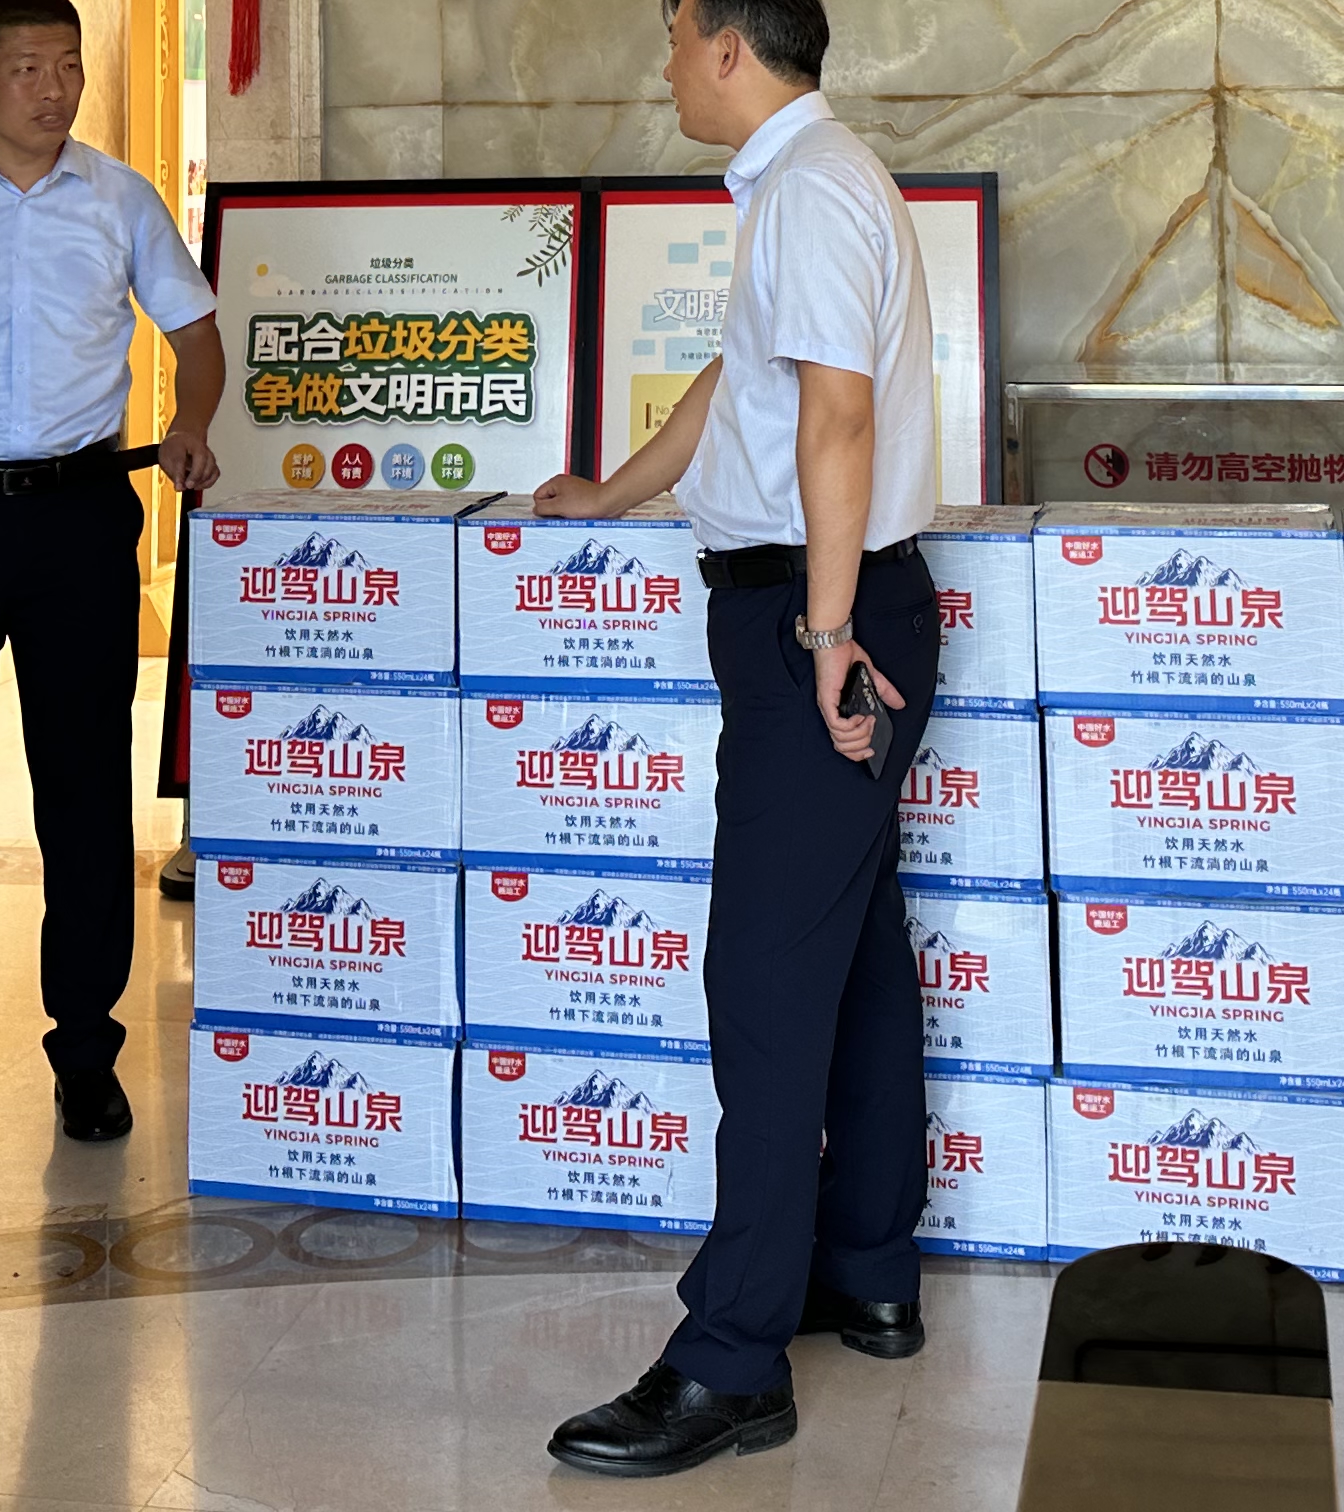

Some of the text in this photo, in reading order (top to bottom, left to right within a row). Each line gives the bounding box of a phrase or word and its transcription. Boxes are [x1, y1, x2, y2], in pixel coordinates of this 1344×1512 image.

[370, 257, 414, 270] 垃圾分类
[325, 273, 458, 284] GARBAGE CLASSIFICATION
[253, 318, 529, 363] 配合垃圾分类
[251, 372, 527, 417] 争做文明市民
[341, 454, 363, 465] 人人
[442, 454, 464, 465] 绿色
[341, 467, 362, 479] 有责
[441, 467, 463, 479] 环保
[239, 566, 401, 606] 迎驾山泉
[514, 574, 681, 613] 迎驾山泉
[261, 609, 377, 622] YINGJIA SPRING
[1098, 586, 1283, 628] 迎驾山泉
[538, 618, 658, 630] YINGJIA SPRING
[285, 628, 353, 642] 饮用天然水
[563, 637, 634, 651] 饮用天然水
[1125, 632, 1257, 646] YINGJIA SPRING
[264, 645, 374, 660] 竹根下流淌的山泉
[1153, 652, 1231, 667] 饮用天然水
[543, 655, 656, 669] 竹根下流淌的山泉
[1130, 671, 1256, 687] 竹根下流淌的山泉
[244, 738, 407, 781] 迎驾山泉
[516, 750, 686, 792] 迎驾山泉
[267, 782, 382, 798] YINGJIA SPRING
[899, 767, 980, 808] 山泉
[1110, 769, 1296, 814] 迎驾山泉
[290, 802, 359, 817] 饮用天然水
[540, 795, 661, 809] YINGJIA SPRING
[270, 819, 379, 836] 竹根下流淌的山泉
[565, 814, 636, 829] 饮用天然水
[898, 812, 955, 825] SPRING
[1137, 816, 1270, 832] YINGJIA SPRING
[544, 831, 658, 848] 竹根下流淌的山泉
[1165, 837, 1244, 853] 饮用天然水
[1142, 855, 1269, 873] 竹根下流淌的山泉
[246, 910, 407, 957] 迎驾山泉
[521, 923, 690, 971] 迎驾山泉
[268, 955, 383, 973] YINGJIA SPRING
[919, 951, 990, 993] 山泉
[292, 975, 360, 992] 饮用天然水
[545, 969, 665, 988] YINGJIA SPRING
[1122, 957, 1310, 1005] 迎驾山泉
[272, 992, 380, 1011] 竹根下流淌的山泉
[570, 990, 641, 1007] 饮用天然水
[921, 995, 965, 1009] RING
[548, 1007, 662, 1027] 竹根下流淌的山泉
[1149, 1004, 1284, 1022] YINGJIA SPRING
[1178, 1026, 1257, 1043] 饮用天然水
[1155, 1044, 1282, 1063] 竹根下流淌的山泉
[241, 1083, 403, 1132] 迎驾山泉
[518, 1103, 689, 1153] 迎驾山泉
[264, 1128, 379, 1148] YINGJIA SPRING
[287, 1149, 356, 1167] 饮用天然水
[542, 1149, 664, 1169] YINGJIA SPRING
[268, 1165, 376, 1186] 竹根下流淌的山泉
[1107, 1142, 1297, 1195] 迎驾山泉
[568, 1170, 640, 1188] 饮用天然水
[931, 1178, 959, 1189] ING
[546, 1187, 662, 1208] 竹根下流淌的山泉
[1134, 1190, 1269, 1212] YINGJIA SPRING
[1162, 1212, 1242, 1232] 饮用天然水
